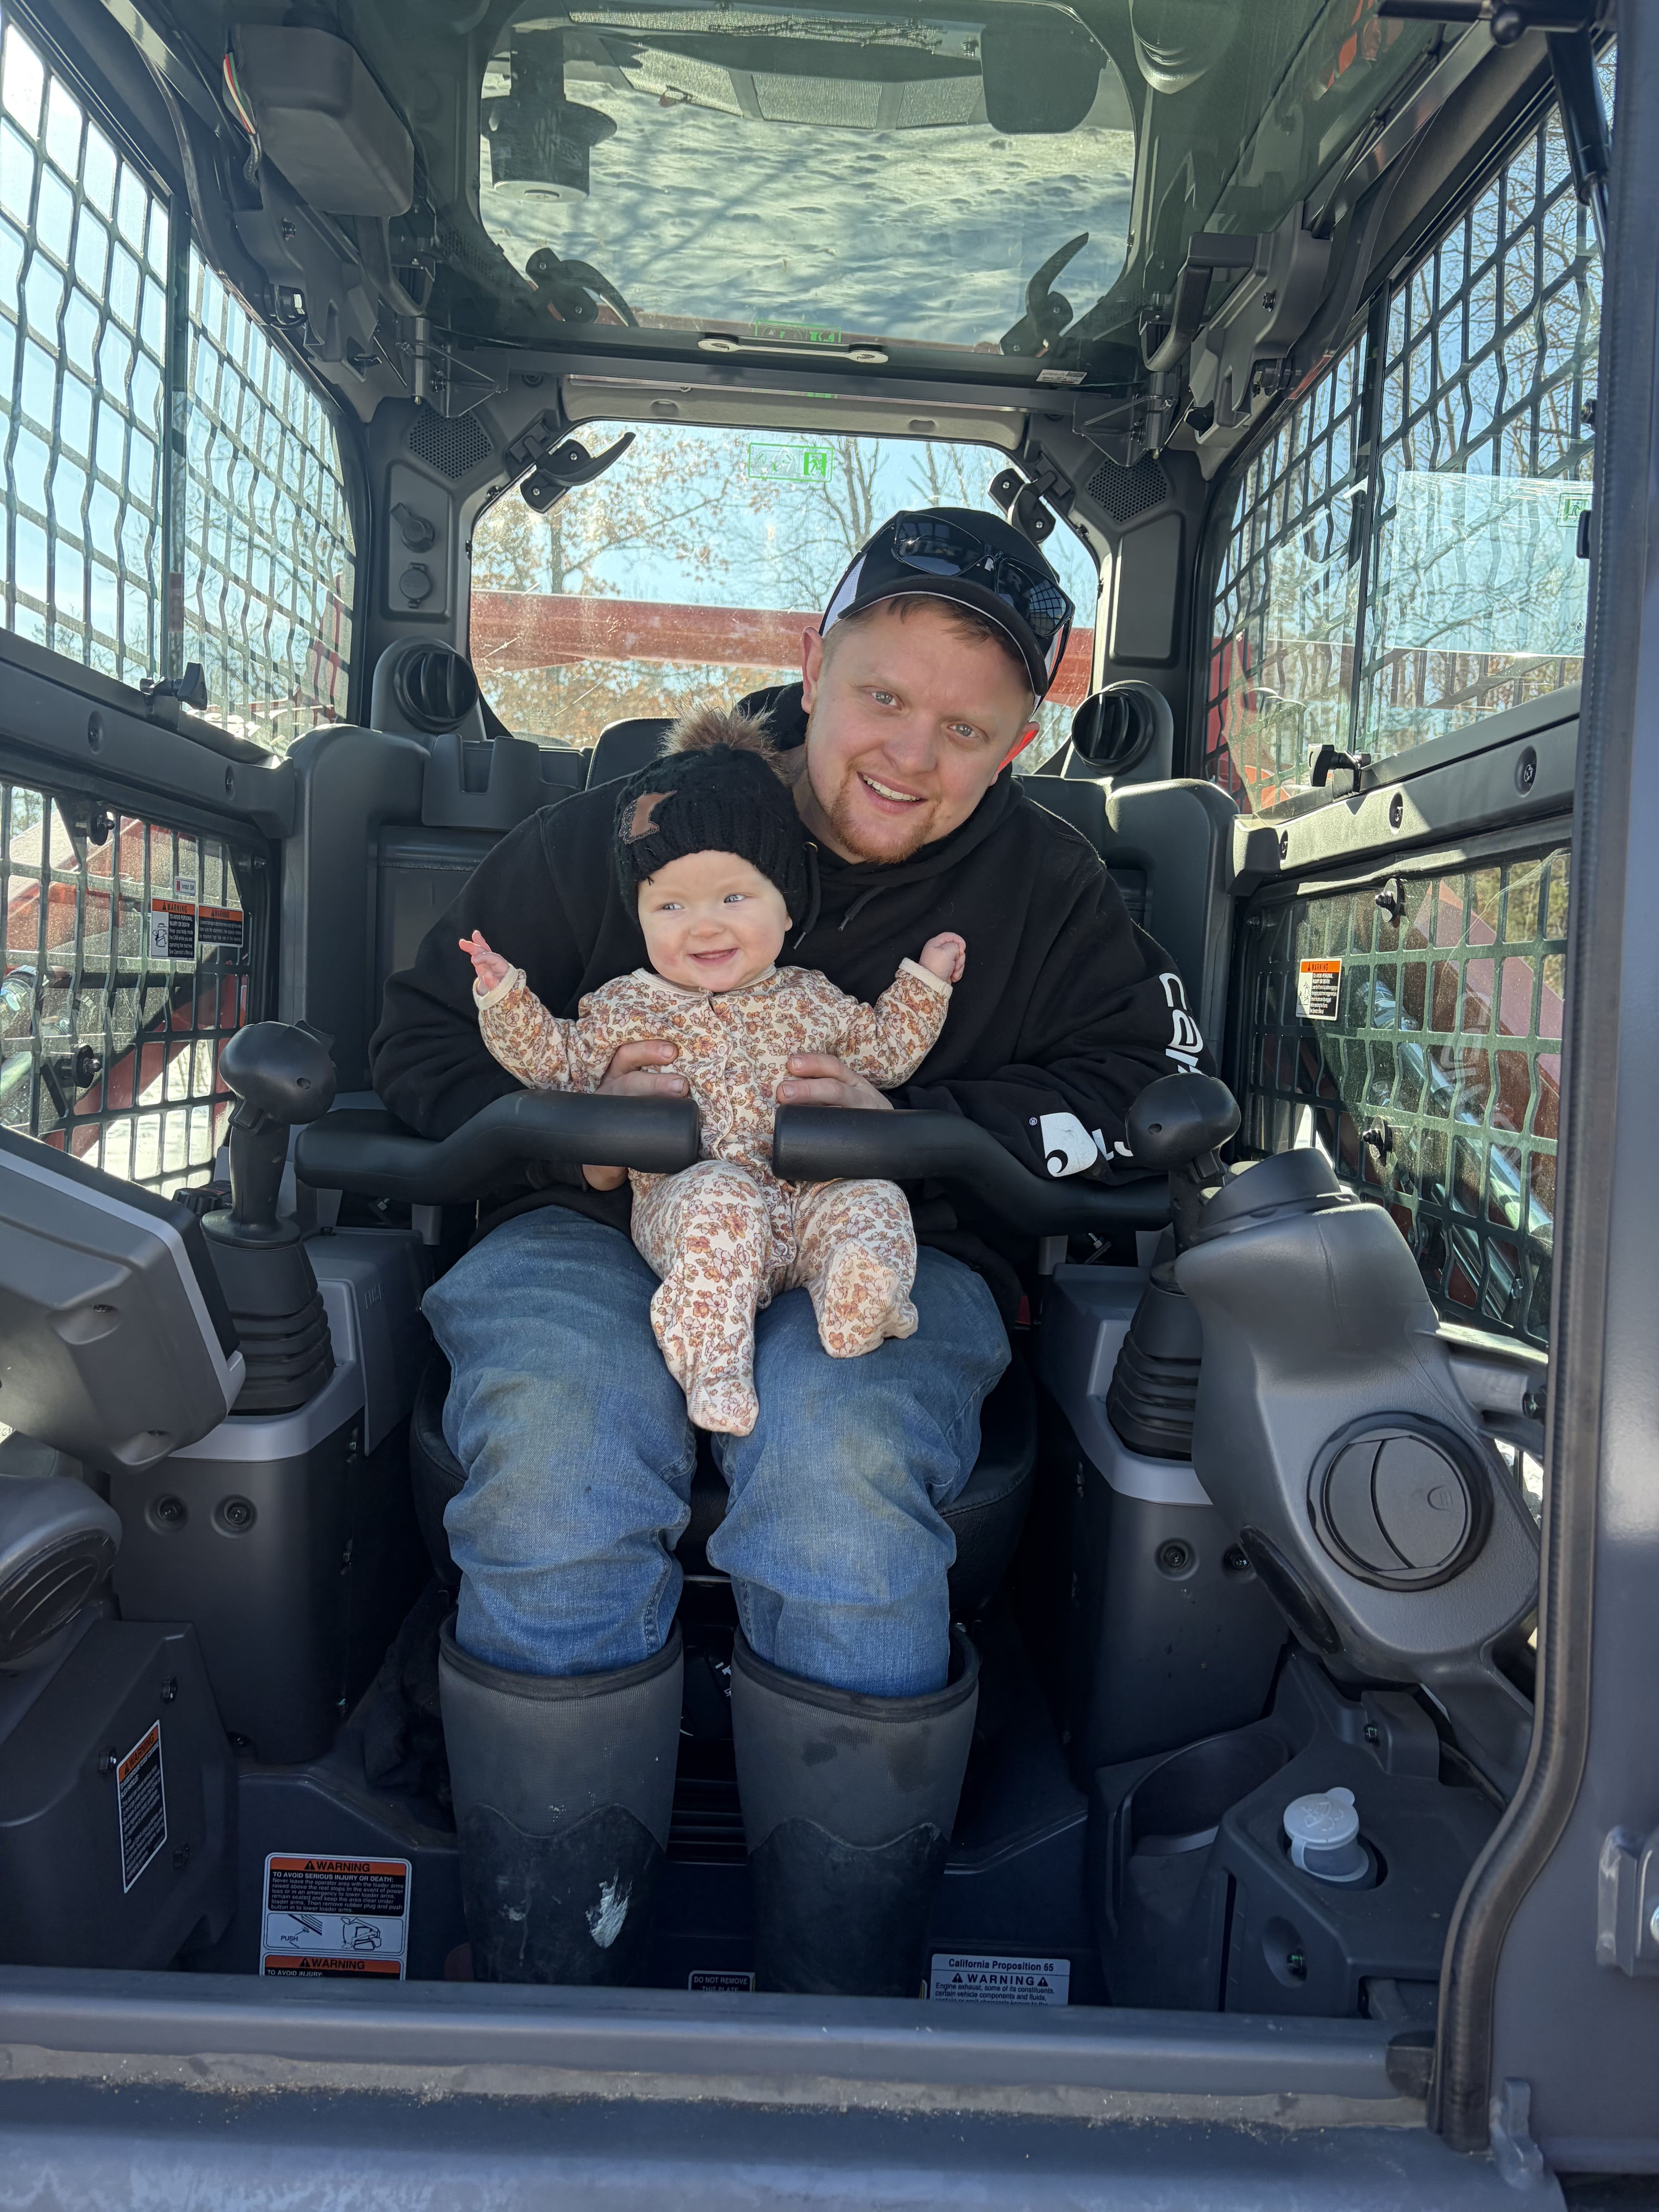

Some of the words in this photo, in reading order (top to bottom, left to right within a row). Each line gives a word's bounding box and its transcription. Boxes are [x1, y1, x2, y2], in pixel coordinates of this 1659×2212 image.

[167, 903, 187, 913] WARNING
[215, 910, 229, 919] WARNING
[129, 1734, 154, 1768] WARNING
[316, 1861, 370, 1872] WARNING
[311, 1958, 365, 1969] WARNING
[949, 1958, 989, 1969] California
[992, 1961, 1041, 1972] Proposition
[1044, 1963, 1054, 1972] 65
[967, 1973, 1034, 1986] WARNING
[936, 1982, 956, 1991] Engine
[958, 1983, 983, 1991] exhaust,
